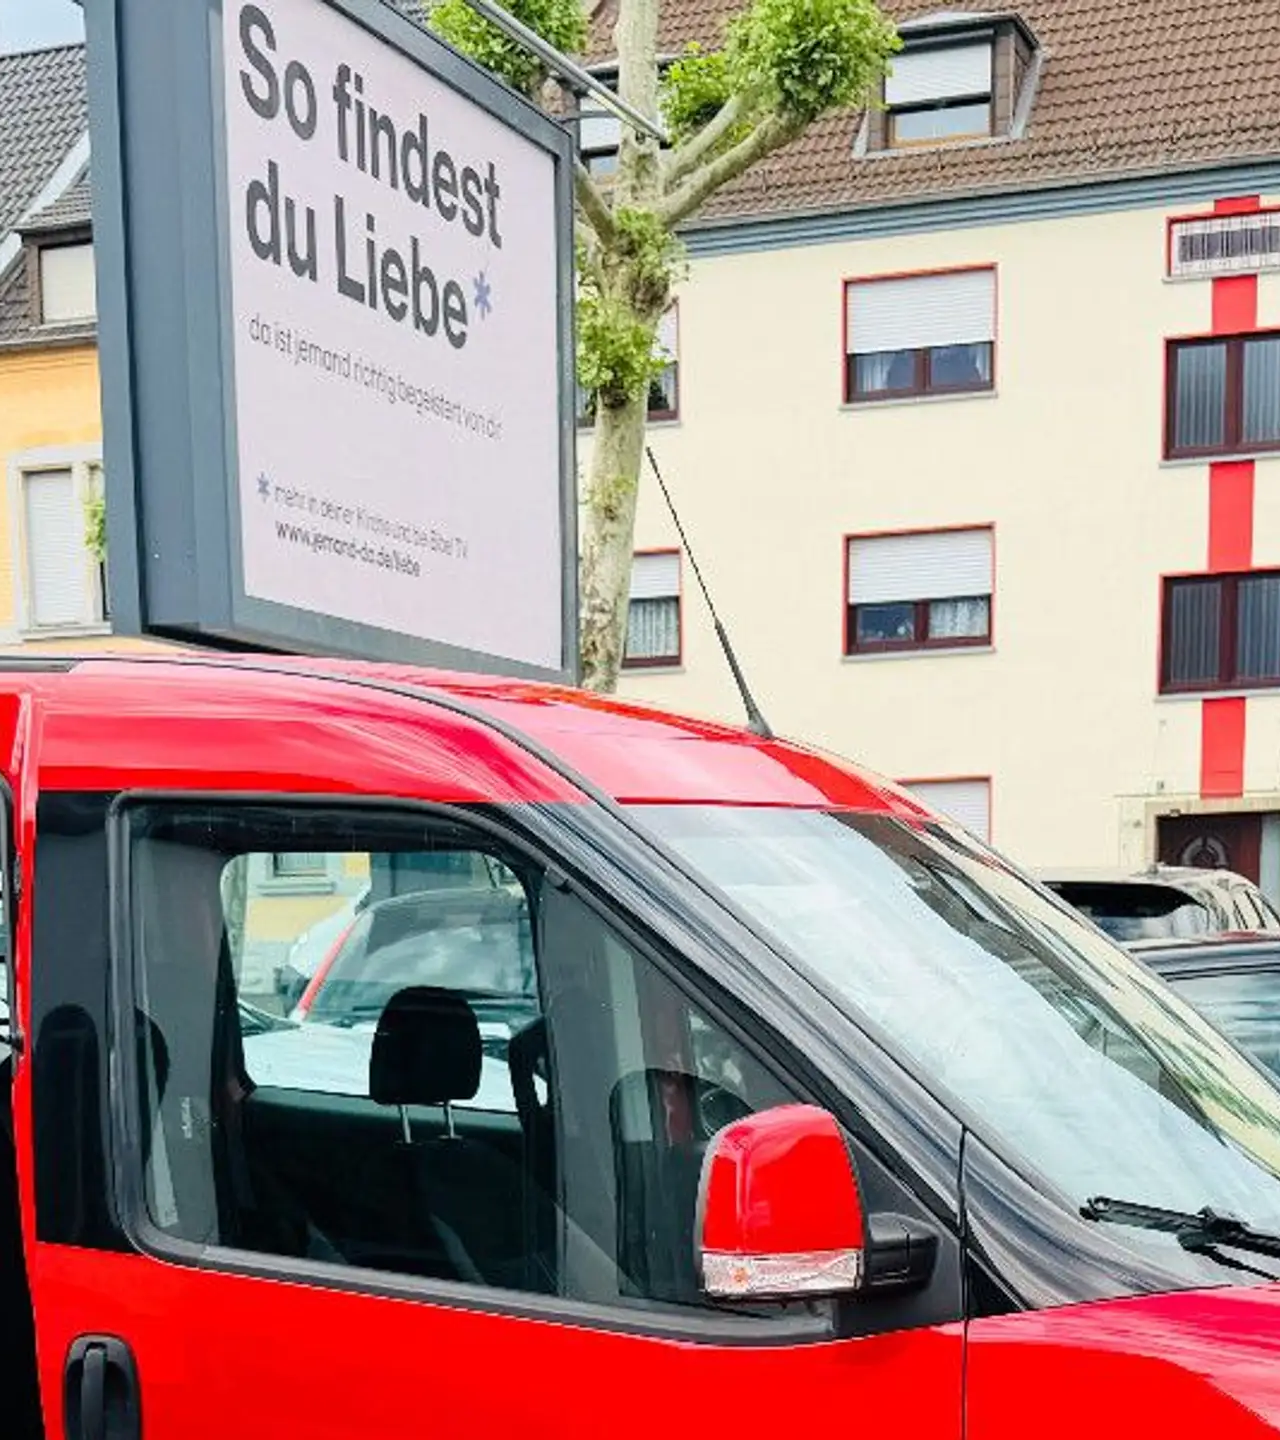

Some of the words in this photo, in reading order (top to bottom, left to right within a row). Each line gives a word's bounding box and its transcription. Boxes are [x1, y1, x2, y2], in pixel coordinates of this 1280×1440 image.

[239, 4, 317, 141] So
[333, 63, 502, 249] findest
[246, 159, 317, 283] du
[248, 313, 272, 345] da
[274, 321, 293, 354] ist
[294, 330, 351, 379] jemand
